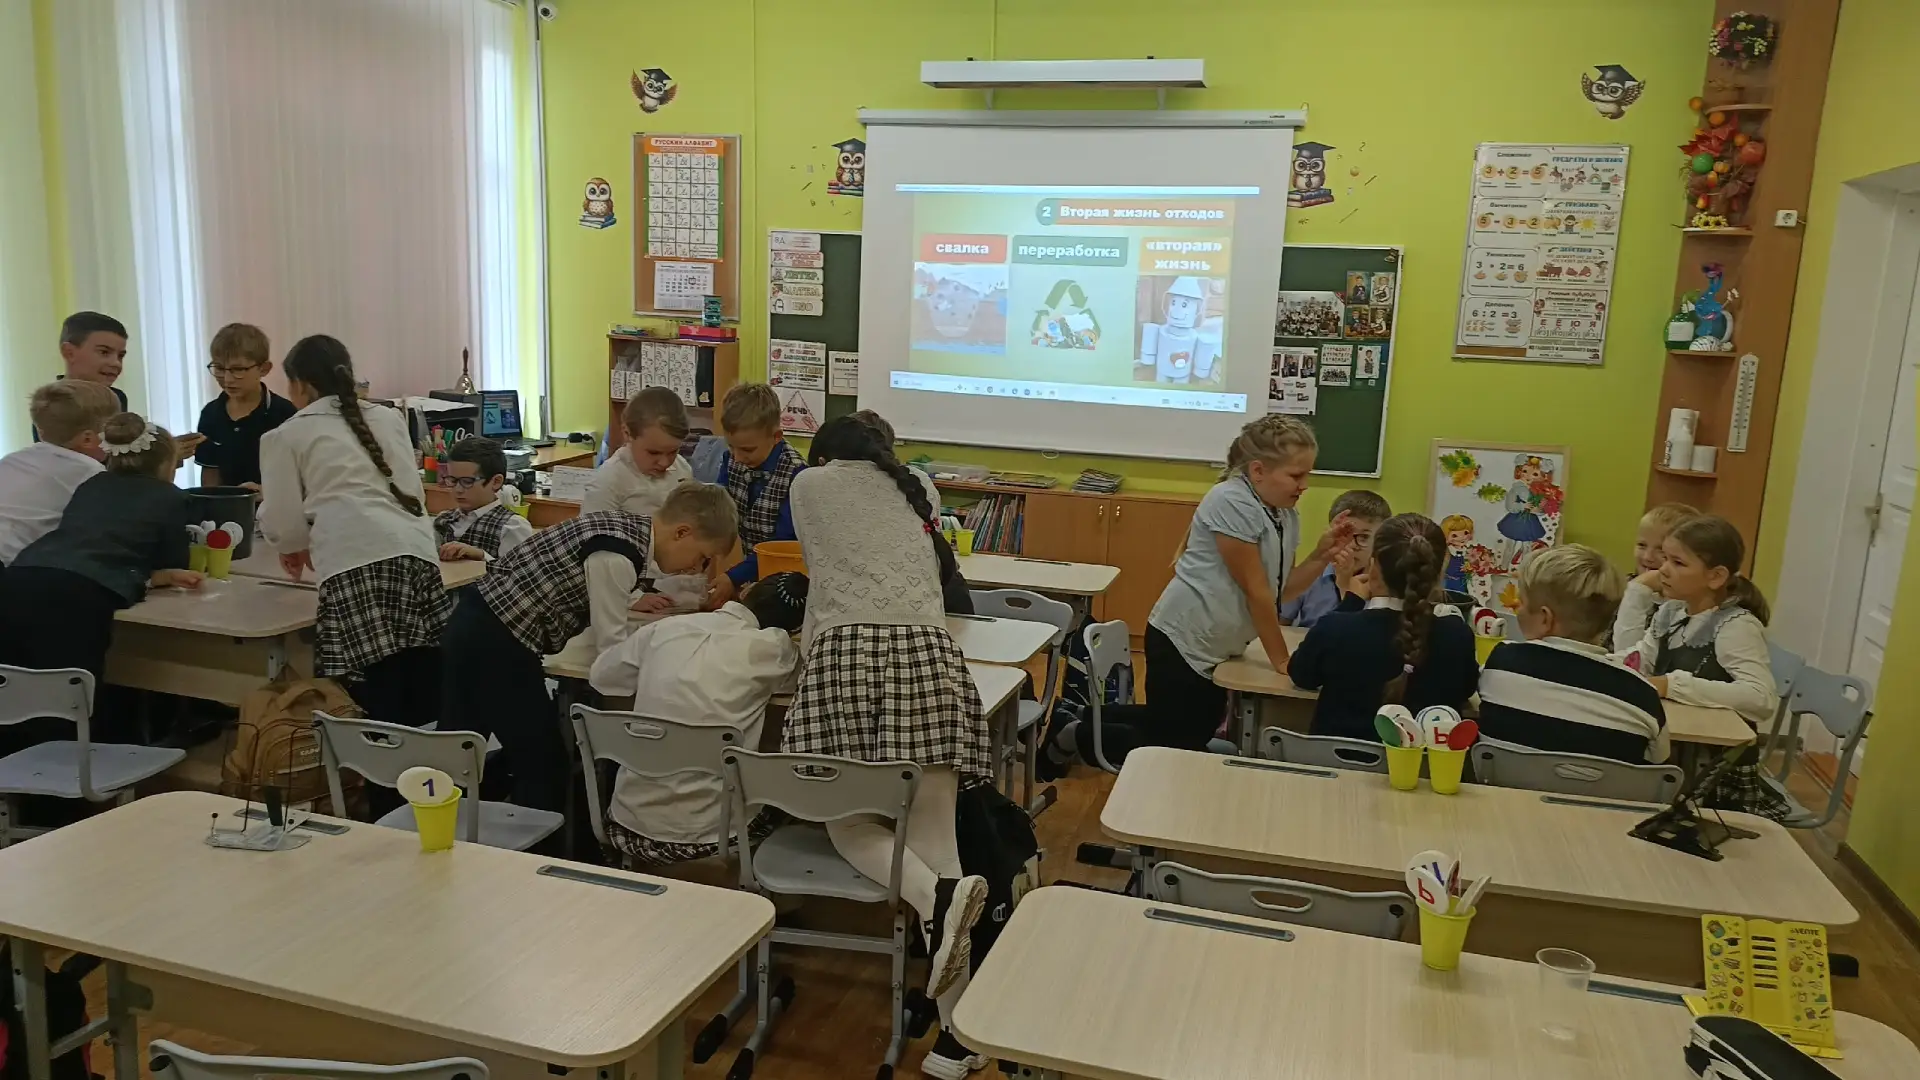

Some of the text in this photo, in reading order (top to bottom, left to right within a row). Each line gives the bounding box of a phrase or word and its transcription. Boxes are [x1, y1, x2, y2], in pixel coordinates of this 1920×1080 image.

[1485, 166, 1492, 174] 3
[1510, 166, 1518, 175] 2
[1534, 167, 1541, 175] 5
[1042, 206, 1225, 220] 2 Вторая жизнь отходов
[1480, 216, 1487, 224] 5
[1507, 217, 1514, 225] 3
[1531, 217, 1538, 225] 2
[935, 243, 989, 254] свалка
[1018, 244, 1120, 258] переработка
[1146, 241, 1223, 254] «вторая»
[1155, 259, 1211, 271] жизнь
[1500, 262, 1506, 270] 2
[787, 406, 808, 414] РЕЧЬ
[422, 778, 434, 797] 1
